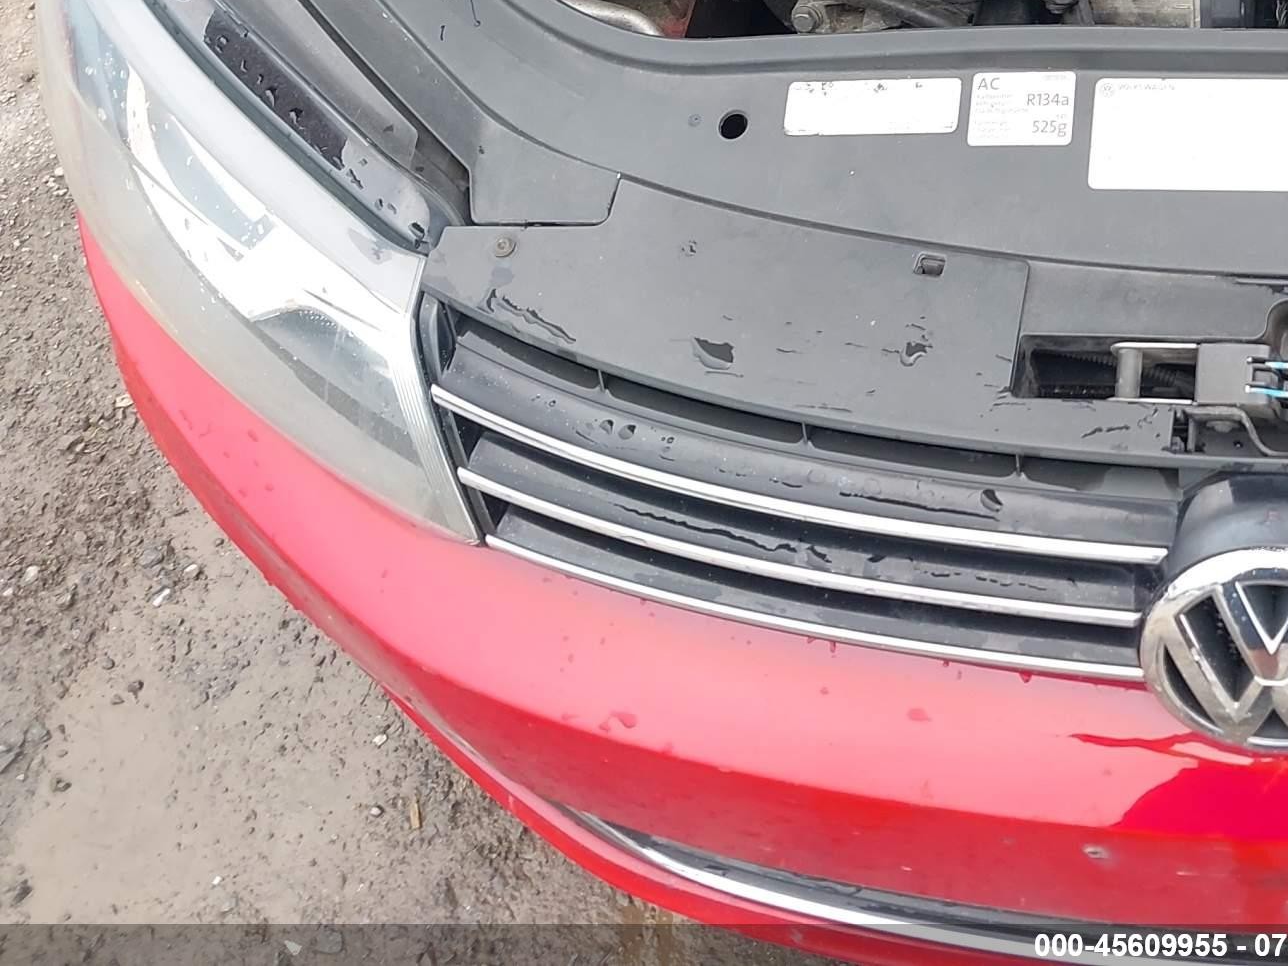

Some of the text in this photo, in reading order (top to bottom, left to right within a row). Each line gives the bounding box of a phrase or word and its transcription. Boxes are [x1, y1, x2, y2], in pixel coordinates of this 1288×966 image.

[977, 77, 1001, 90] AC
[1026, 93, 1070, 106] R134a
[1031, 120, 1068, 138] 525g
